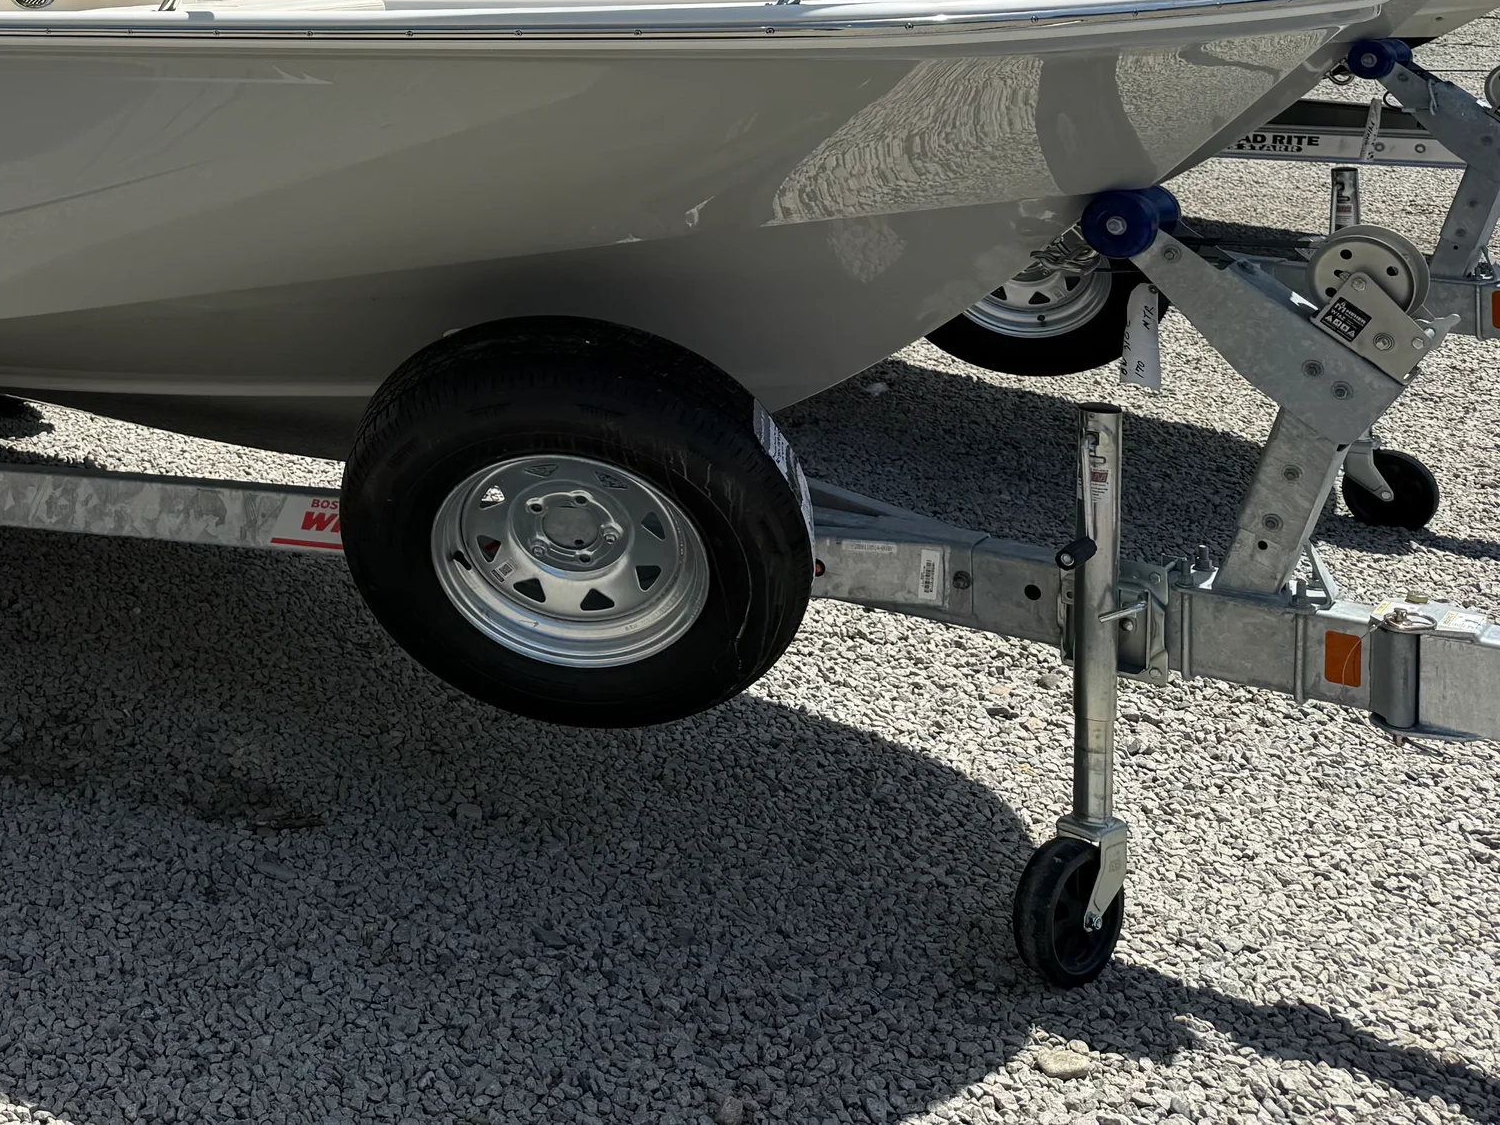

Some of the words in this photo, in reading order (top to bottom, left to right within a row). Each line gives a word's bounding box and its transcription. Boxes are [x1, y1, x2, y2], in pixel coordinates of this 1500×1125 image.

[1237, 133, 1267, 144] AD
[1272, 134, 1320, 146] RITE
[311, 498, 339, 510] BOS
